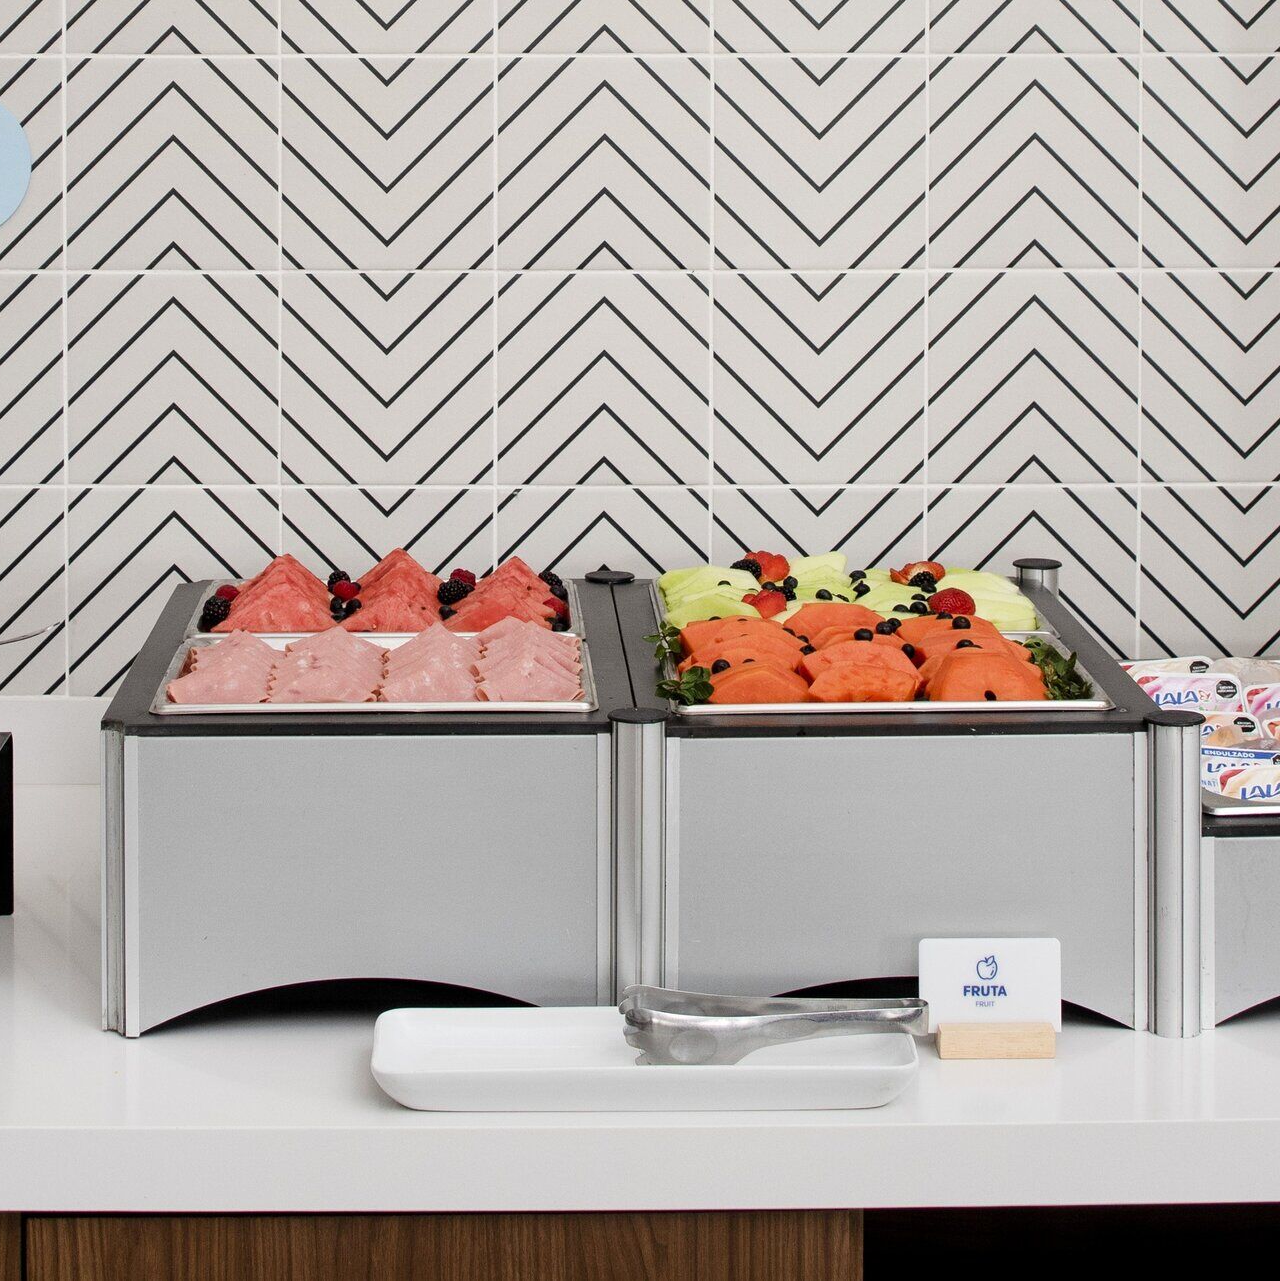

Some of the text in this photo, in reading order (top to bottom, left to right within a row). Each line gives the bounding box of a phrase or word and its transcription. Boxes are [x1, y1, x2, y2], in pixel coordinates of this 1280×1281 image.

[1155, 690, 1199, 706] LALA
[1204, 749, 1255, 758] ENDULZADO
[963, 985, 1008, 996] FRUTA
